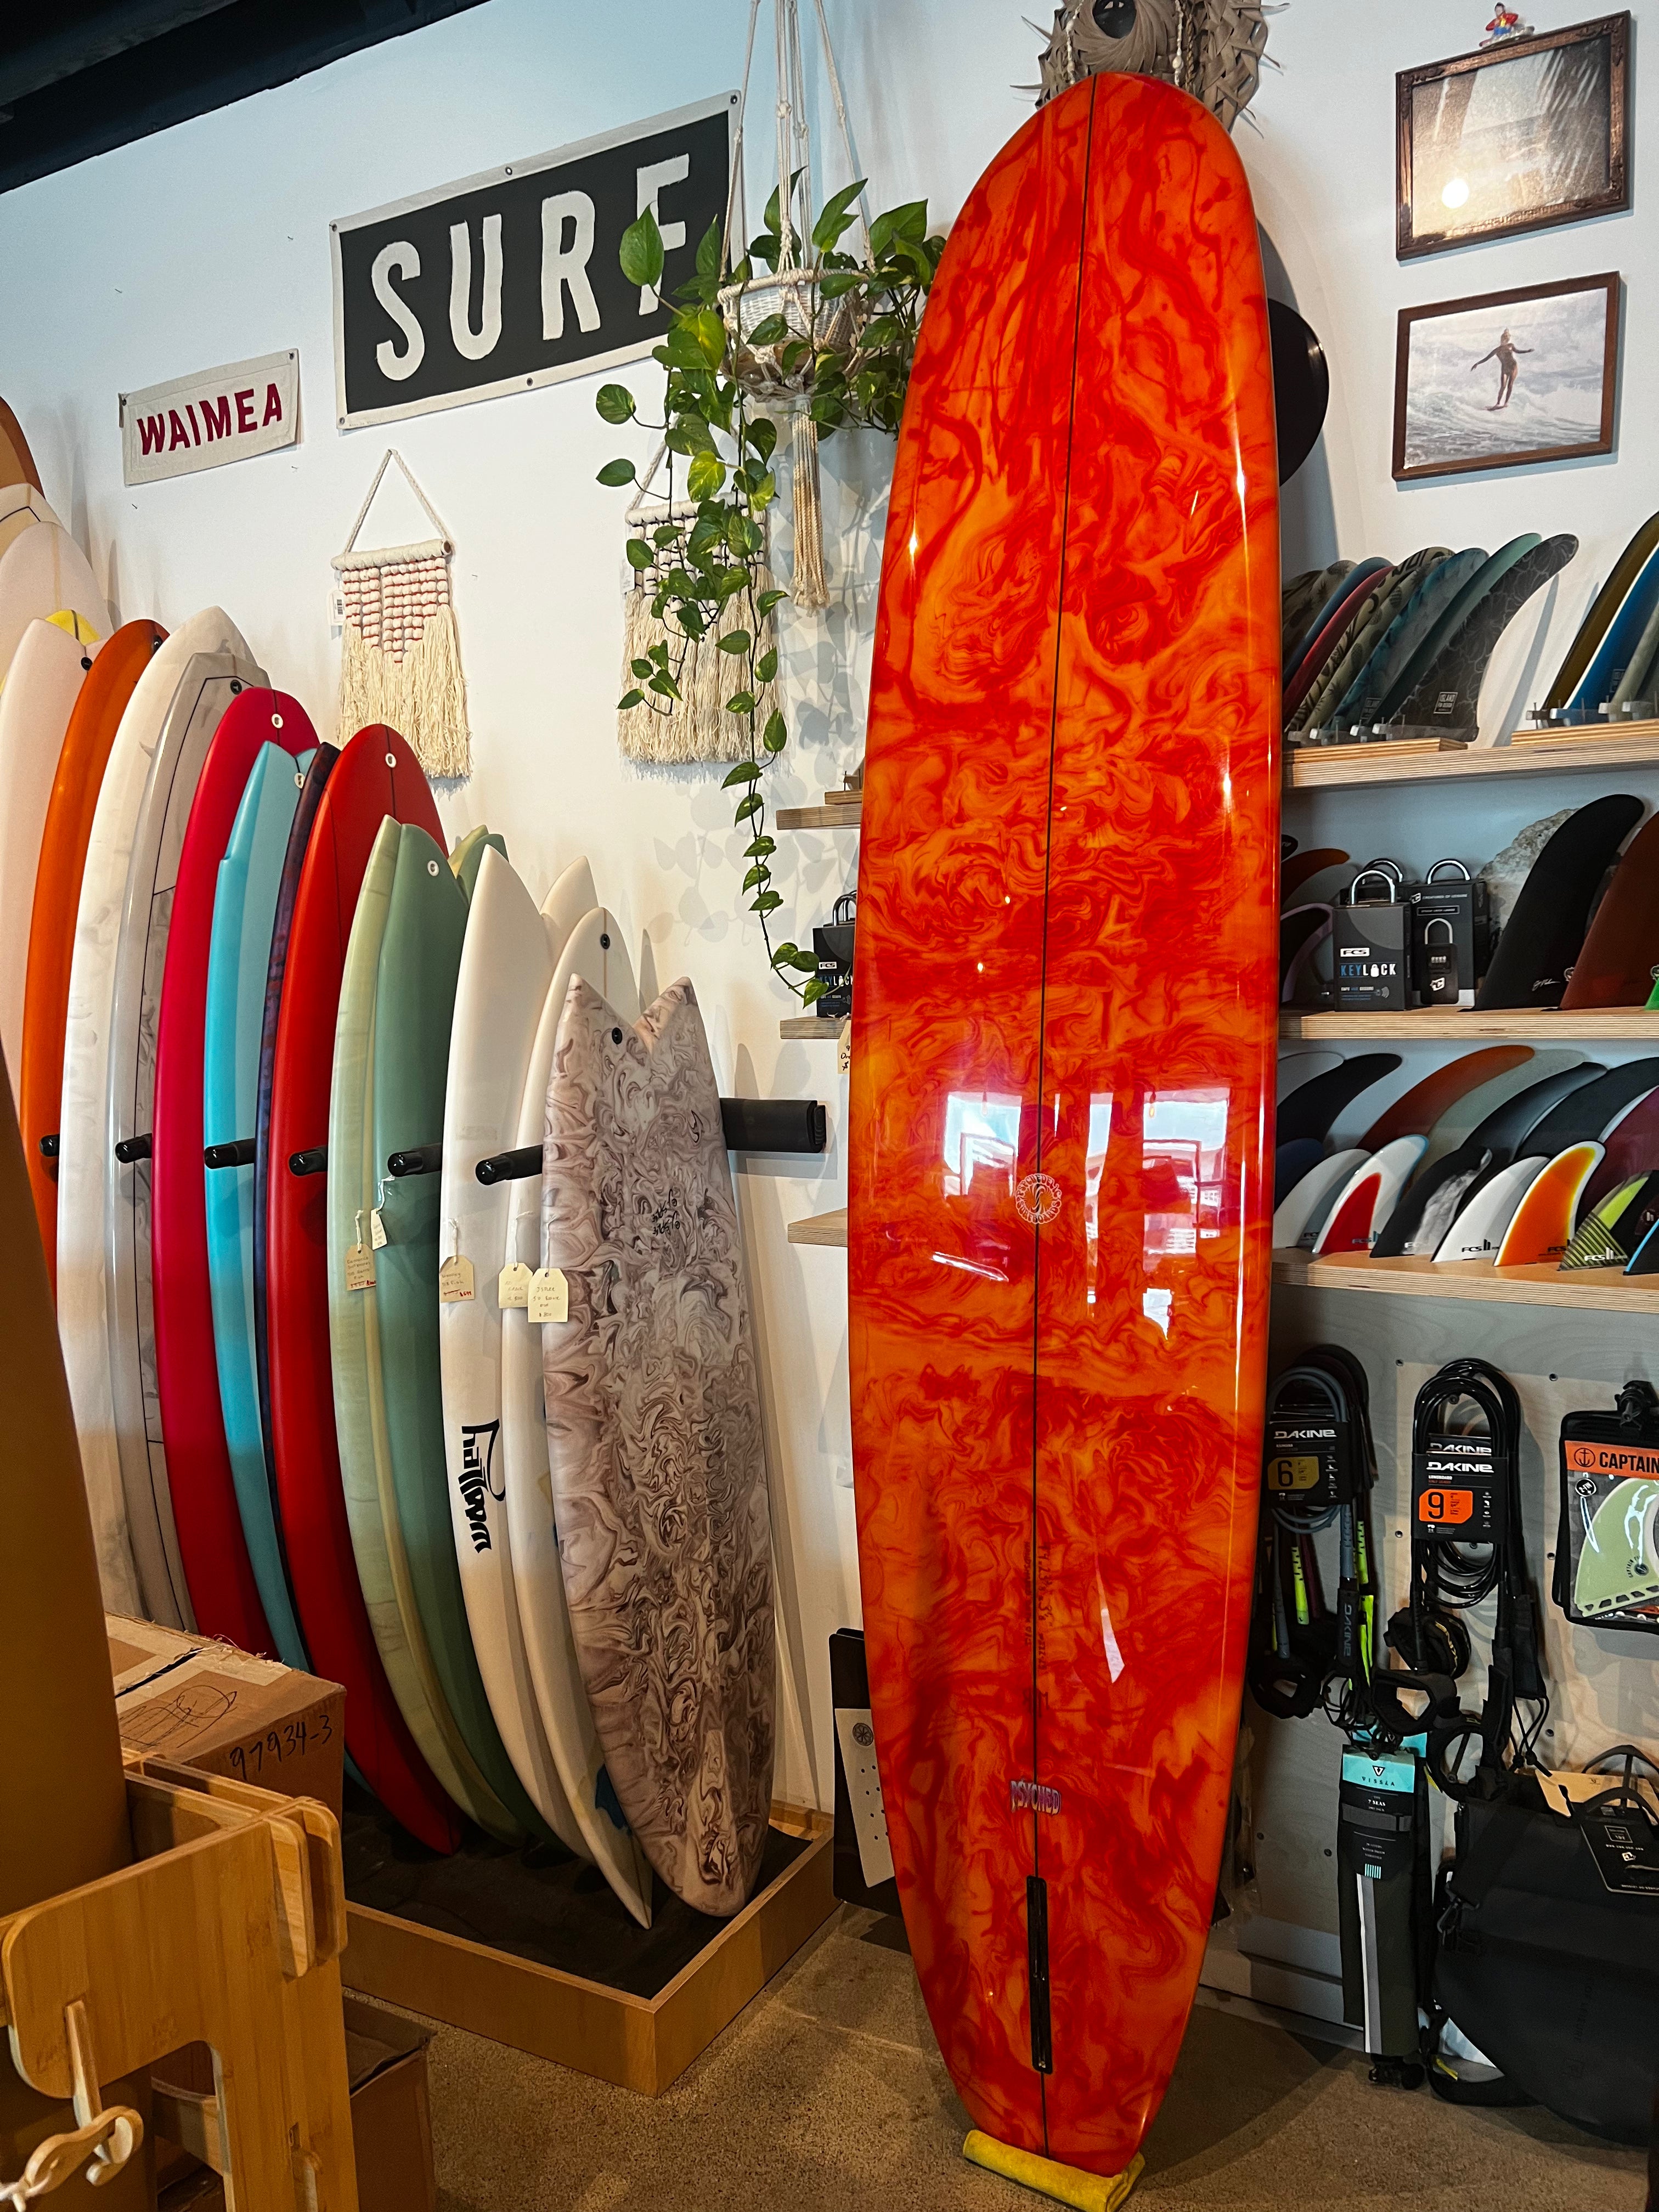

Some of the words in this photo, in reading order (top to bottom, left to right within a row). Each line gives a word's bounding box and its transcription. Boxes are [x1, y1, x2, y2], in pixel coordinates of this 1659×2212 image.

[371, 153, 690, 381] SURF
[137, 383, 283, 455] WAIMEA
[1273, 1430, 1338, 1439] DAKINE
[1429, 1443, 1492, 1454] DAKINE
[1277, 1460, 1294, 1487] 6
[1426, 1462, 1494, 1473] DAKINE
[1599, 1452, 1659, 1474] CAPTAIN
[458, 1418, 506, 1554] woolley
[1428, 1492, 1444, 1519] 9
[1344, 1603, 1352, 1657] DAKINE
[229, 1714, 332, 1781] 97934-3
[1362, 1776, 1395, 1787] VISSLA
[1011, 1780, 1061, 1815] PSYCHED
